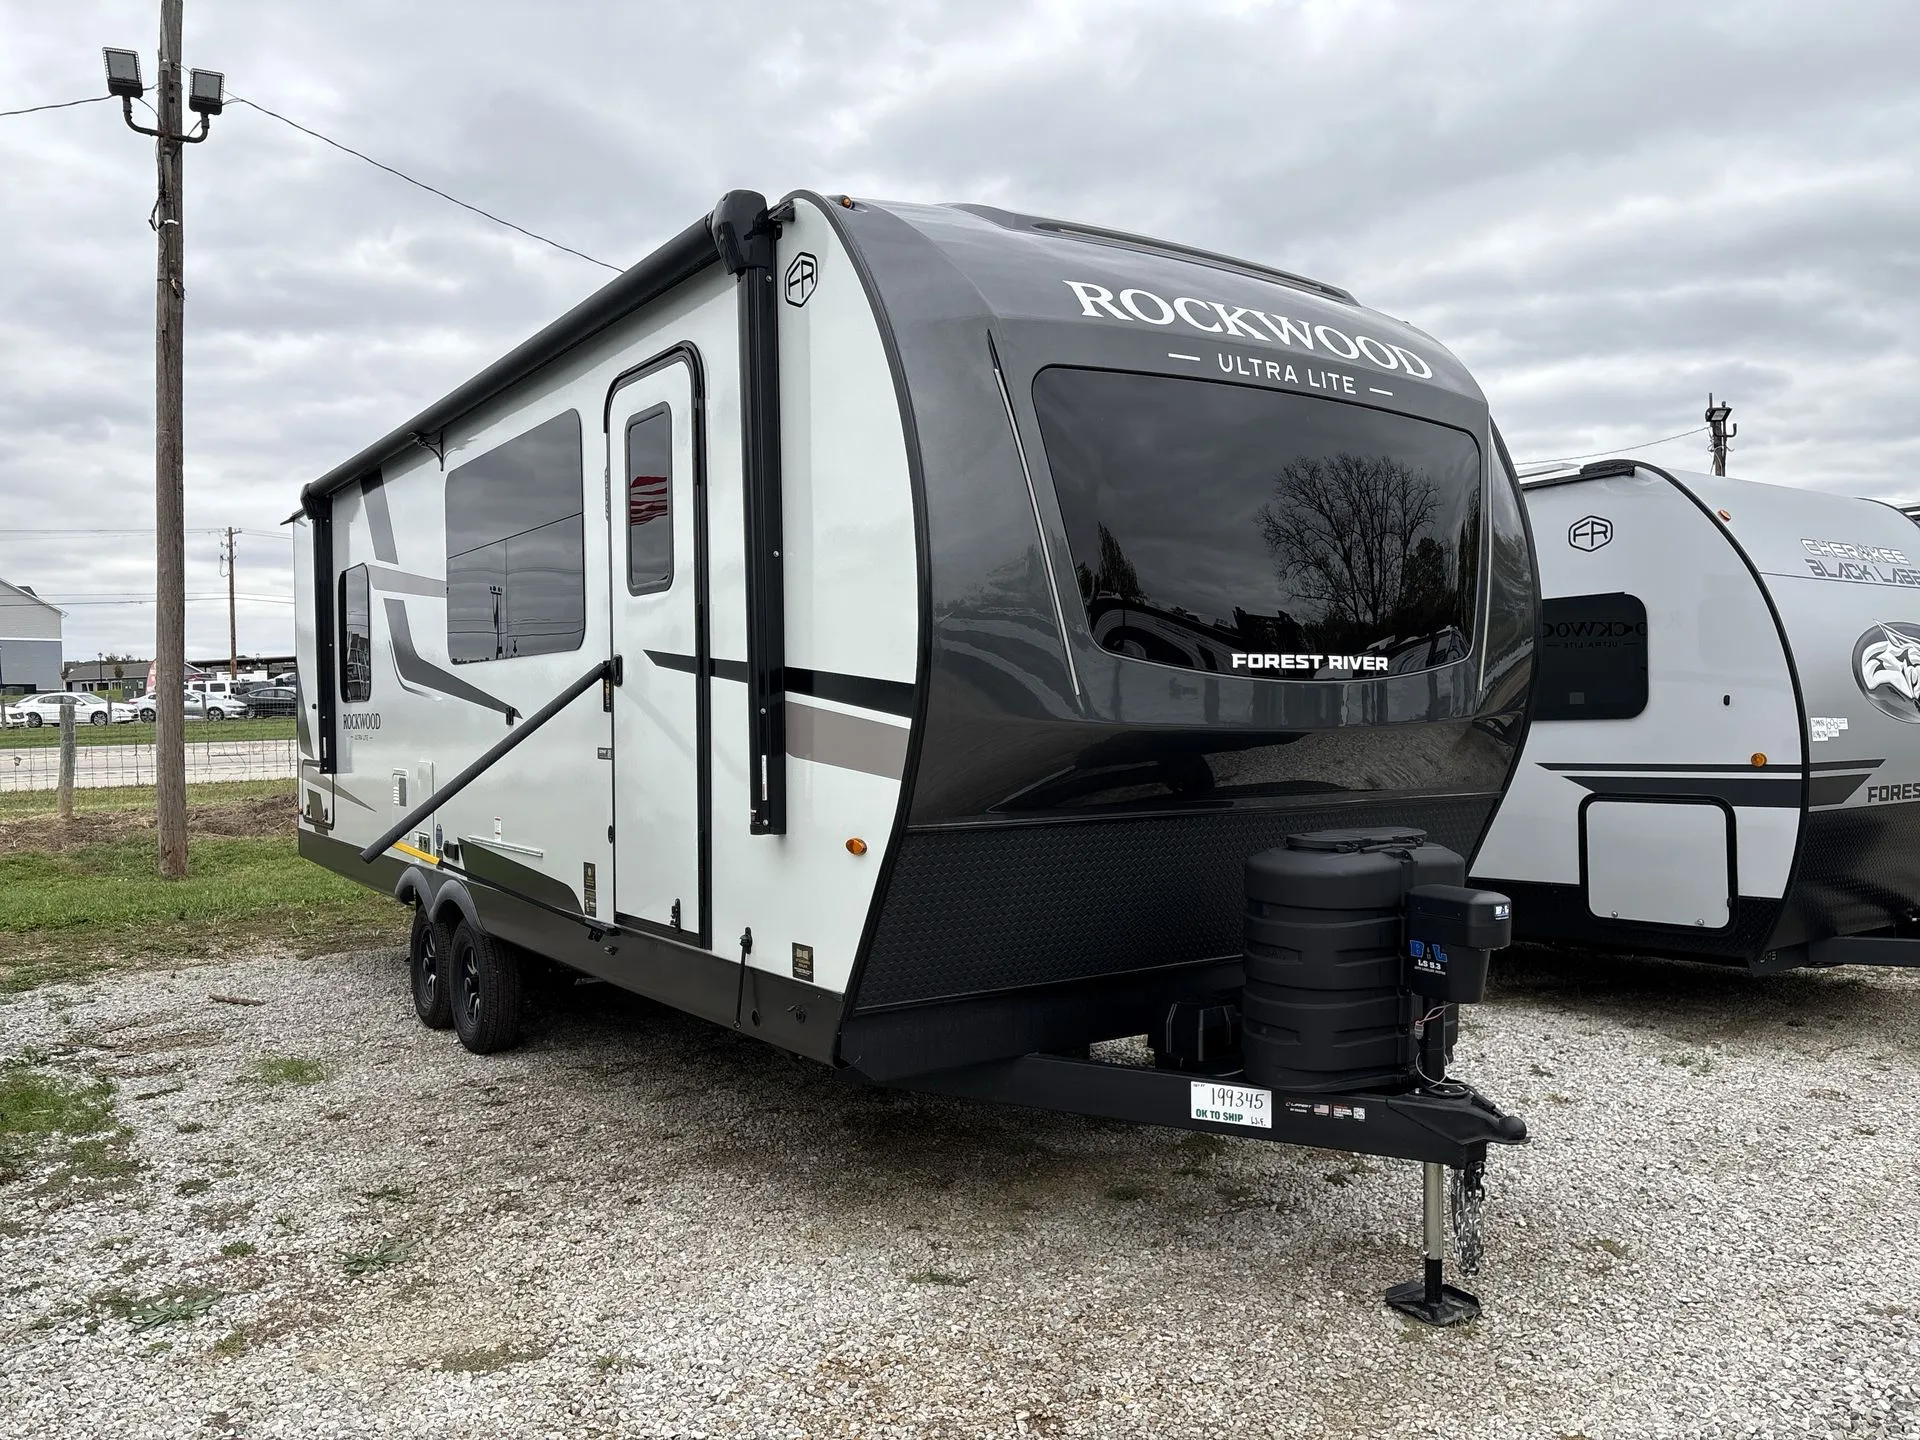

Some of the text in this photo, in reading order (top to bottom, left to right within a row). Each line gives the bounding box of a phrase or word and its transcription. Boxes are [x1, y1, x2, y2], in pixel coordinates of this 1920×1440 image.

[1063, 279, 1433, 380] ROCKWOOD
[1217, 353, 1358, 395] ULTRA LITE
[1804, 558, 1920, 585] BLACK LABE
[1231, 653, 1388, 671] FOREST RIVER
[342, 712, 381, 730] ROCKWOOD
[1867, 782, 1920, 803] FORES
[1211, 1087, 1265, 1110] 199345
[1195, 1108, 1244, 1123] OK TO SHIP
